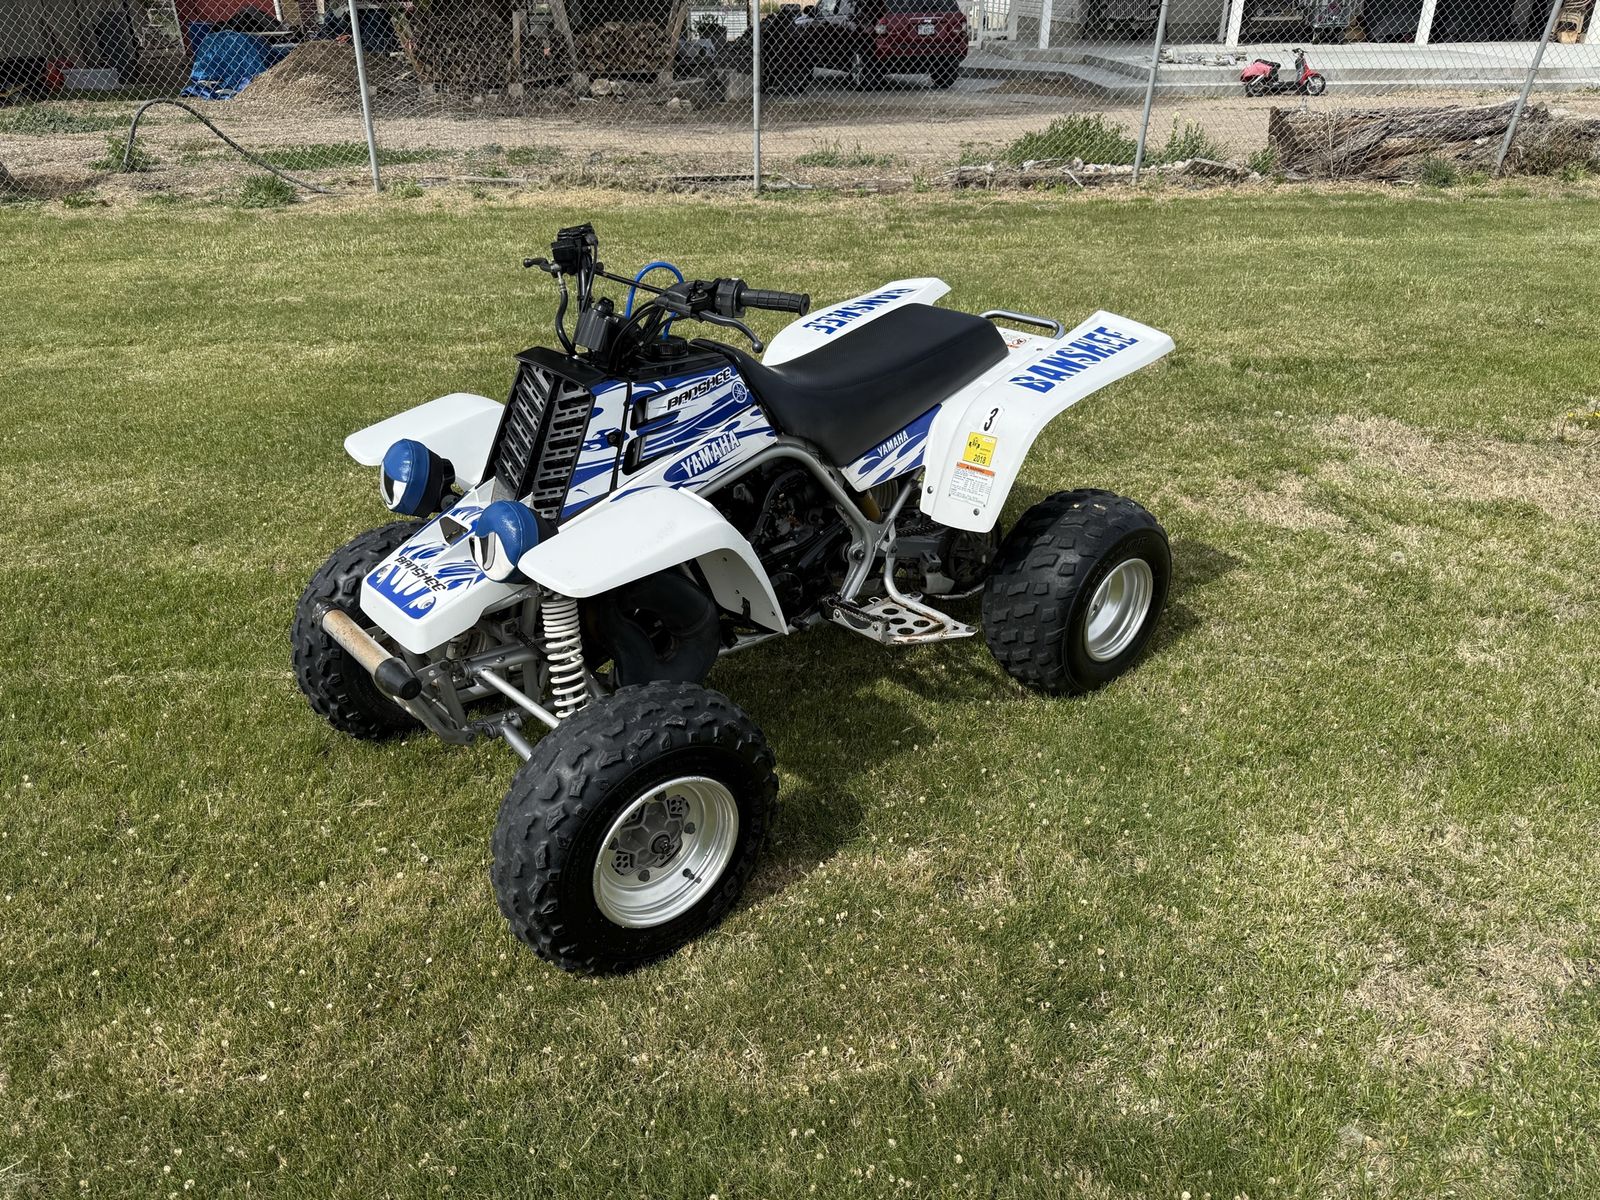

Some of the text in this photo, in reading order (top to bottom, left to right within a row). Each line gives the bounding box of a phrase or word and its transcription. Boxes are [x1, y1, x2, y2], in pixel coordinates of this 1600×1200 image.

[1008, 326, 1139, 394] BANSHEE
[667, 368, 732, 410] BANSHEE
[984, 408, 999, 432] 3
[680, 430, 742, 478] YAMAHA
[877, 430, 909, 457] YAMAHA
[394, 556, 447, 592] BANSHEE
